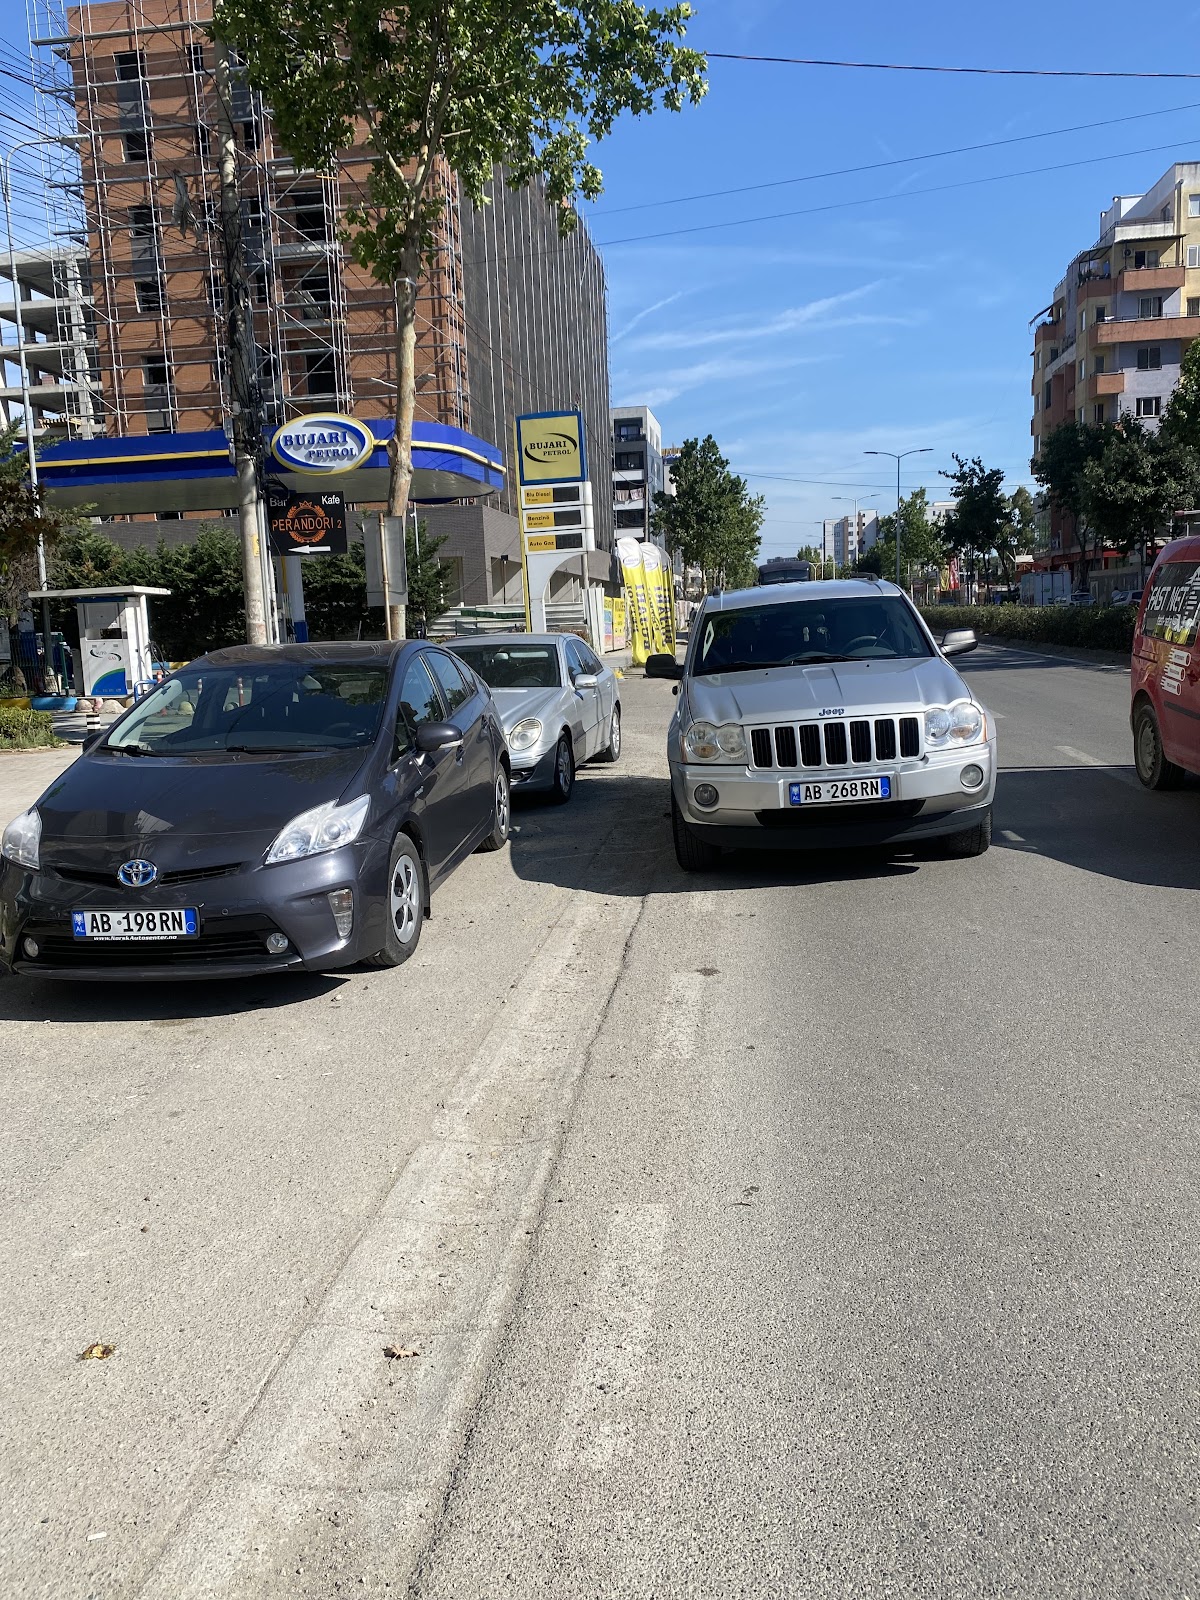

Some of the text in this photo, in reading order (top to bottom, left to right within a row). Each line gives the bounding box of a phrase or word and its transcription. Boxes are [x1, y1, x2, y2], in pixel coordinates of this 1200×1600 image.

[283, 430, 348, 446] BUJARI
[529, 440, 567, 450] BUJARI
[308, 447, 357, 458] PETROL
[542, 449, 571, 457] PETROL
[269, 494, 341, 507] Bar Kafe
[271, 516, 343, 531] PERANDORI 2
[1147, 586, 1190, 612] FAST NET
[818, 708, 845, 716] Jeep
[804, 785, 822, 801] AB
[90, 913, 112, 933] AB
